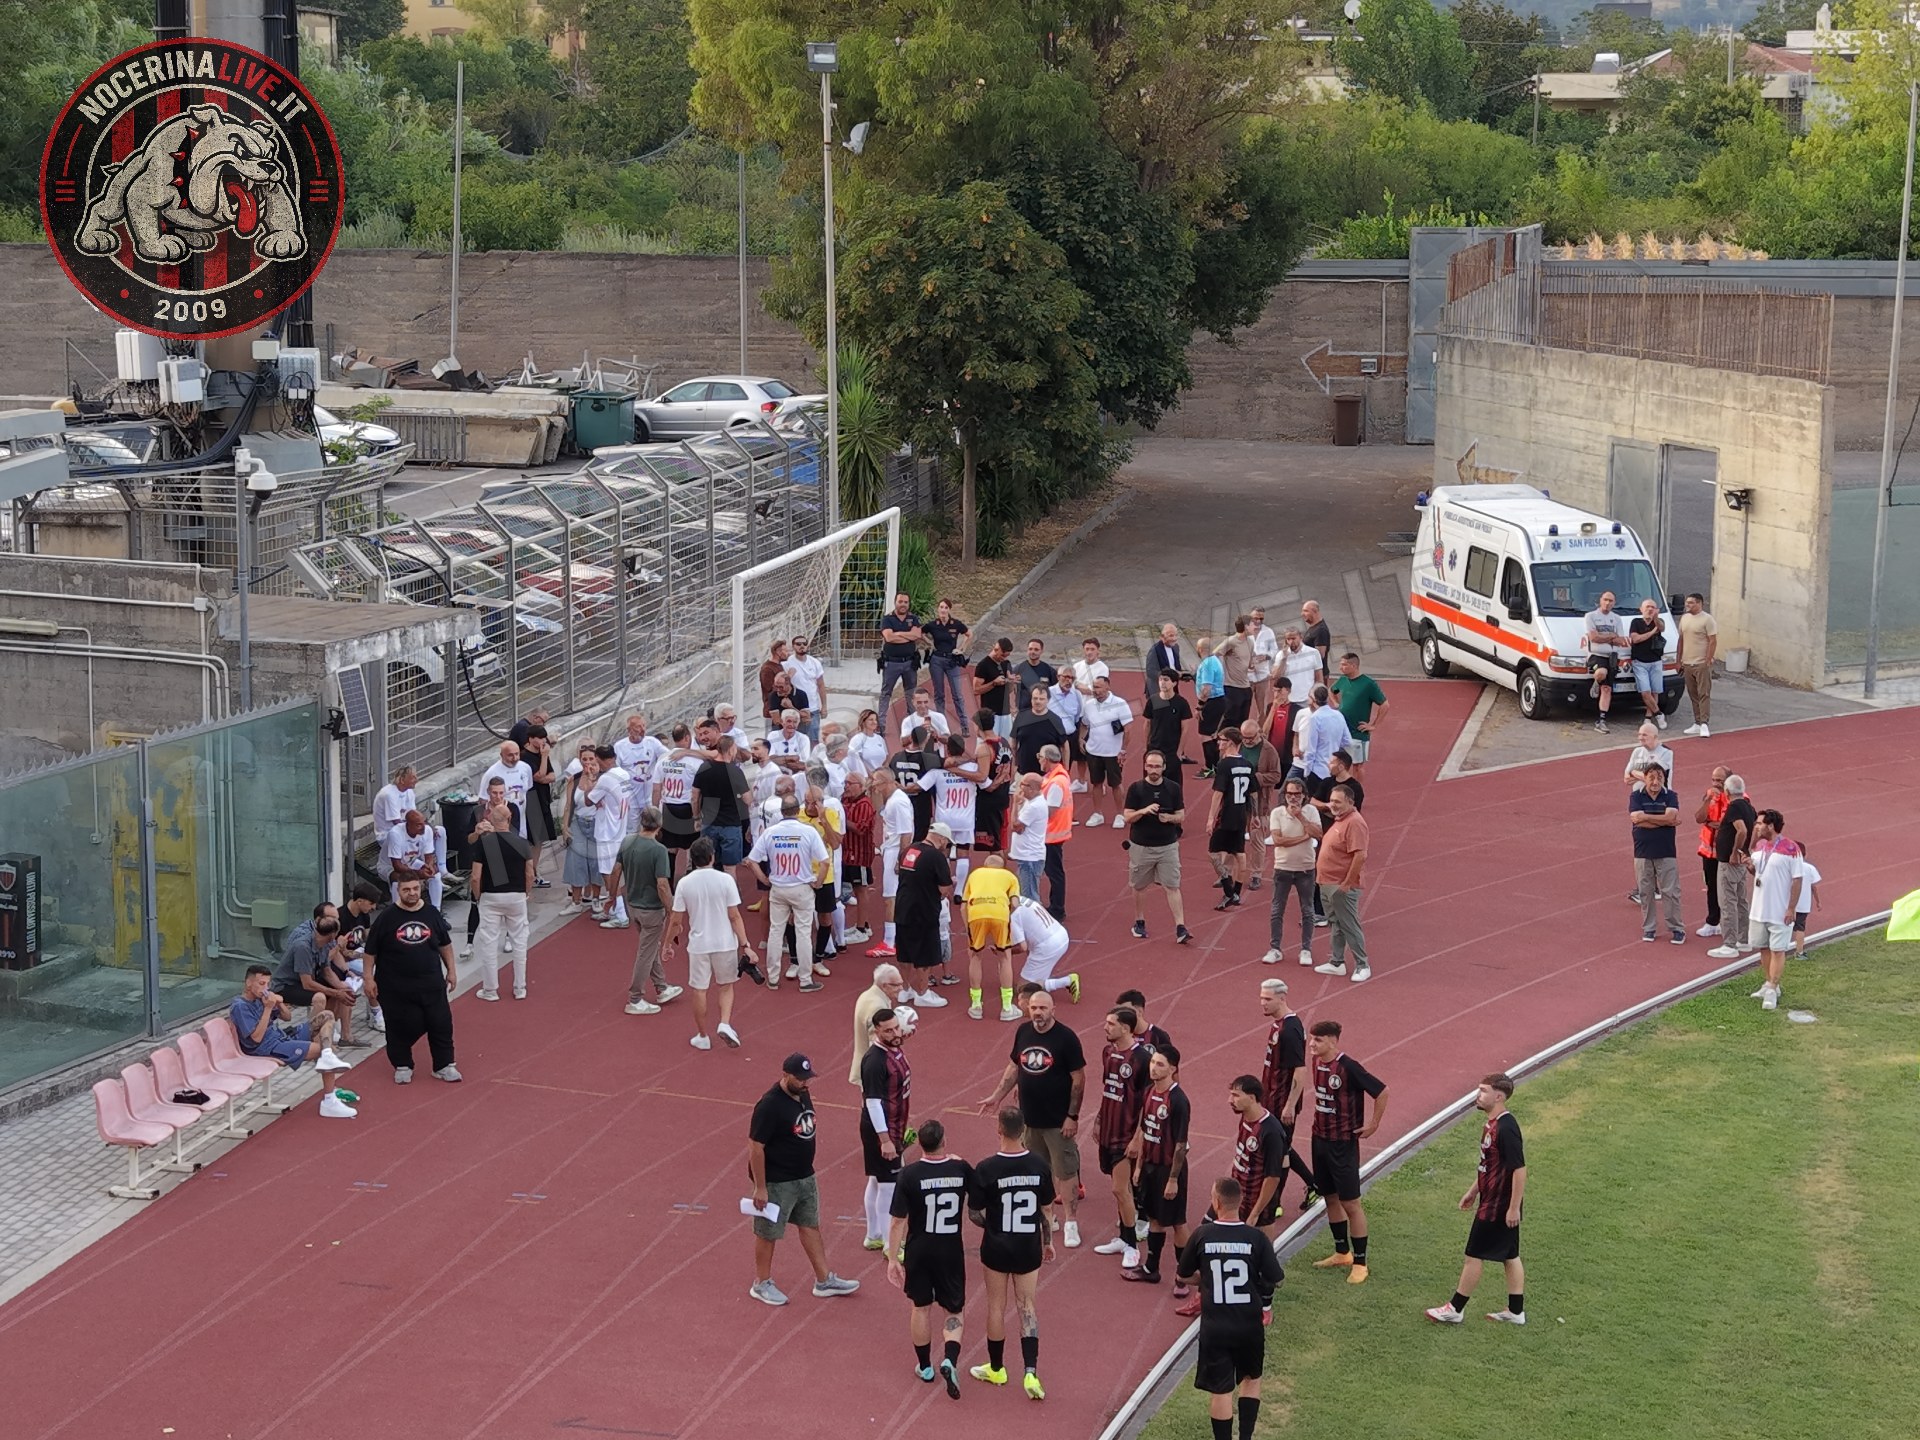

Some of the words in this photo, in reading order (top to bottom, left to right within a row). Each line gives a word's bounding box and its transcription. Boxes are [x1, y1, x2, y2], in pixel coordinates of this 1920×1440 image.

[1568, 538, 1583, 549] SAN
[945, 787, 970, 809] 1910
[1232, 776, 1250, 804] 12
[775, 852, 801, 877] 1910
[924, 1192, 960, 1234] 12
[1001, 1190, 1038, 1233] 12
[1209, 1258, 1251, 1305] 12
